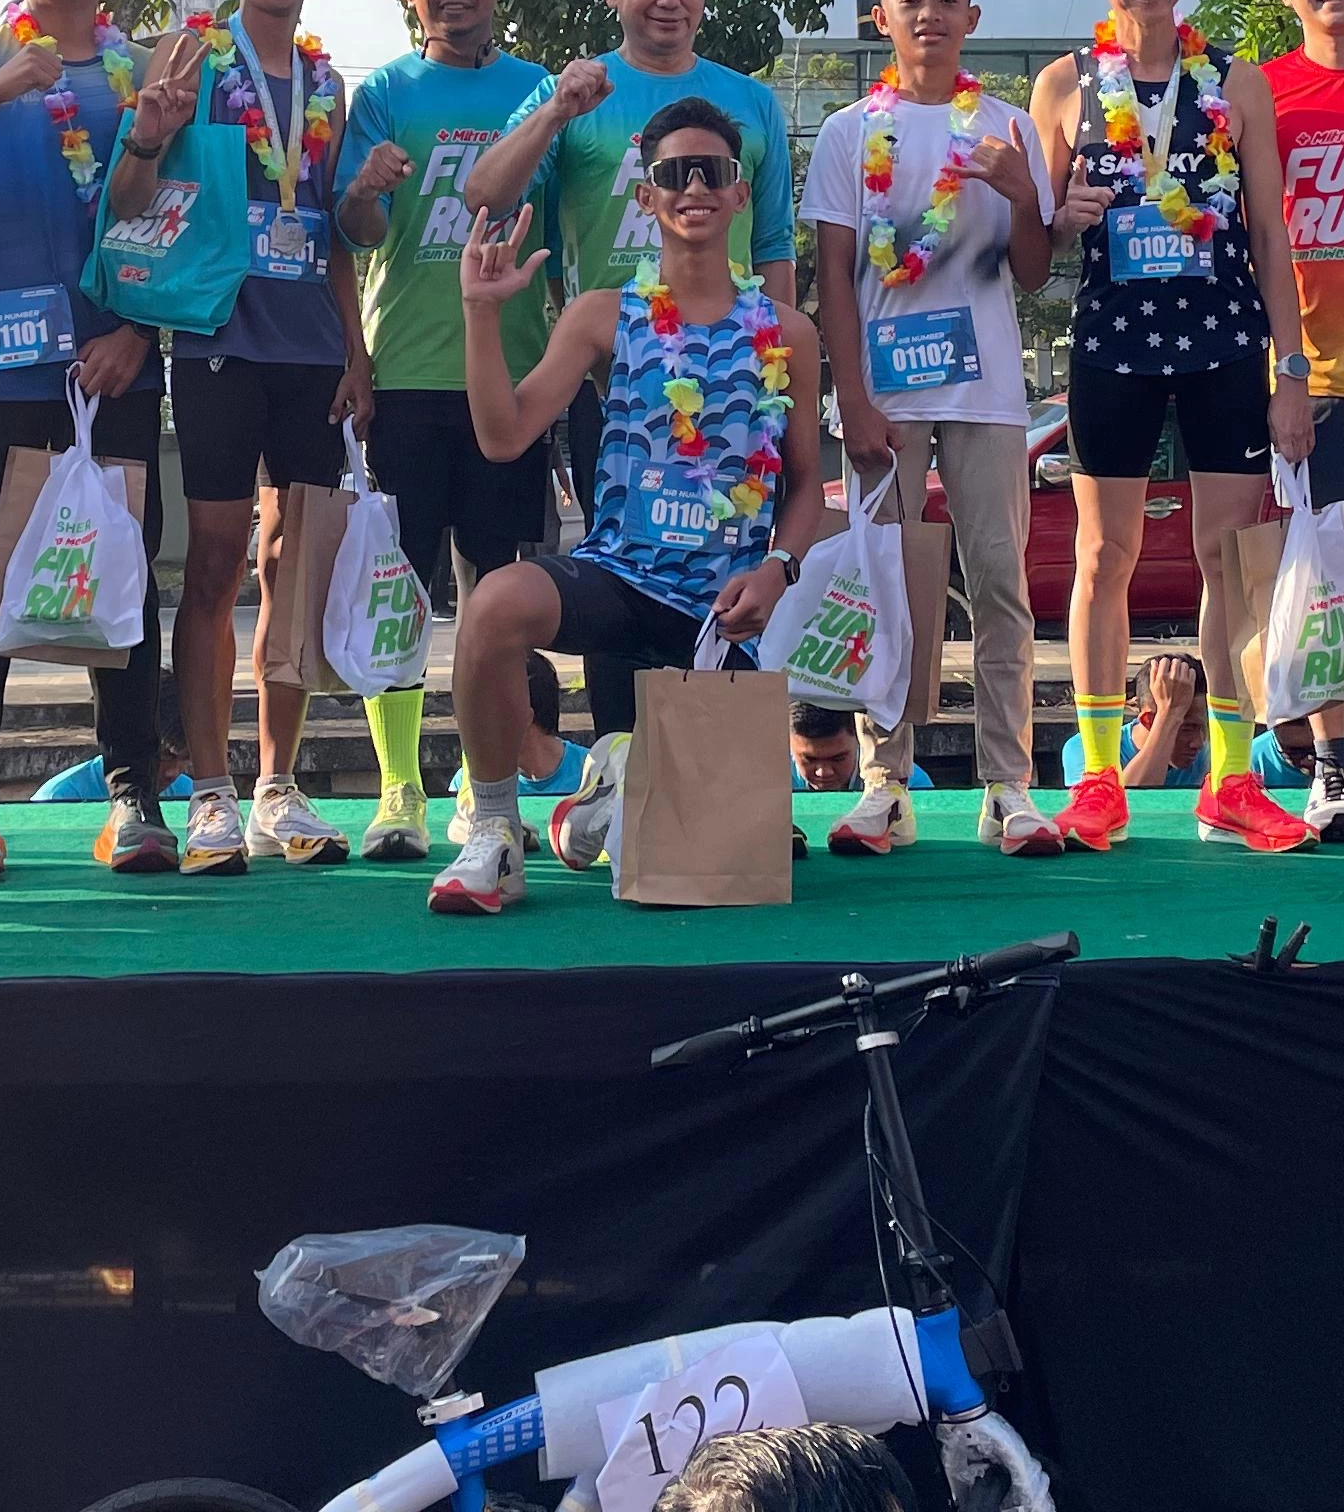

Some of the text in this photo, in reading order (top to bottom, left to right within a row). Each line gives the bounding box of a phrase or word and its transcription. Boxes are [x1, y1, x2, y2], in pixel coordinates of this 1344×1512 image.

[452, 130, 488, 143] Mitra
[1128, 234, 1195, 261] 01026
[892, 341, 956, 372] 01102
[787, 634, 874, 685] RUN
